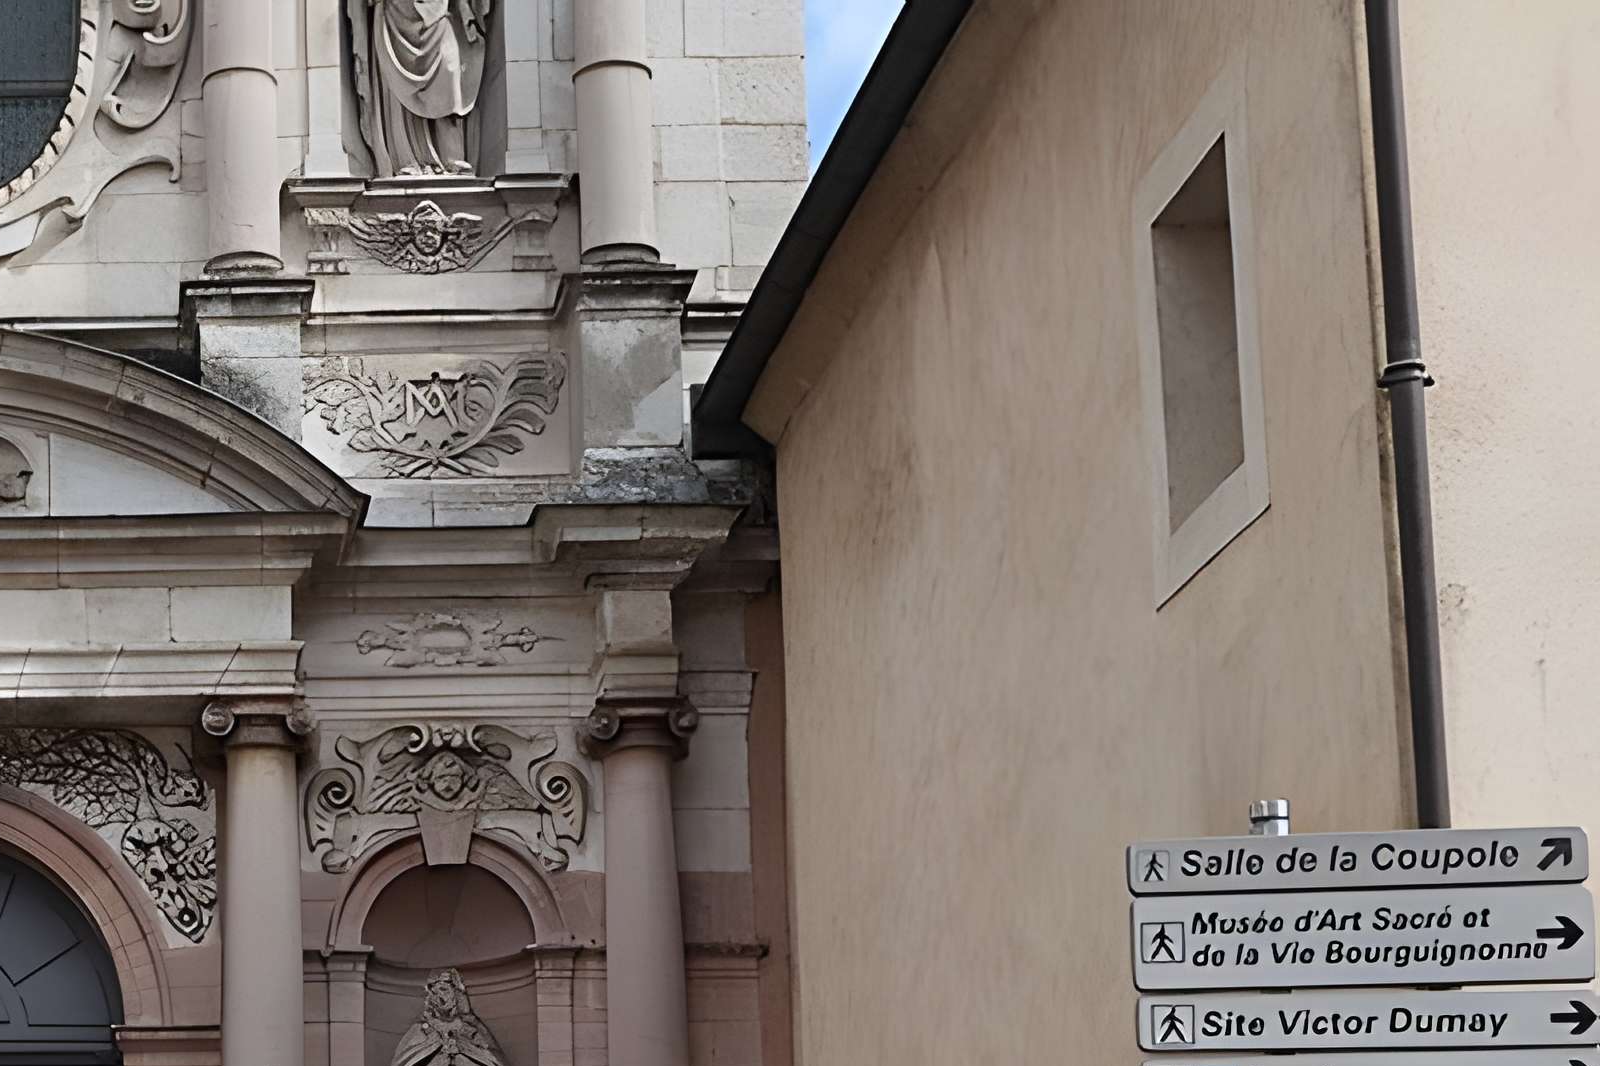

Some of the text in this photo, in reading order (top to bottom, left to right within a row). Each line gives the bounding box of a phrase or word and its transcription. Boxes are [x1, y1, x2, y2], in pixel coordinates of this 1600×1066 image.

[1181, 840, 1519, 877] Salle de la Coupole
[1294, 908, 1362, 933] d'Art
[1463, 908, 1491, 928] et
[1192, 944, 1226, 967] de
[1235, 943, 1259, 966] la
[1325, 938, 1548, 968] Bourguignonne
[1201, 1007, 1509, 1038] Site Victor Dumay
